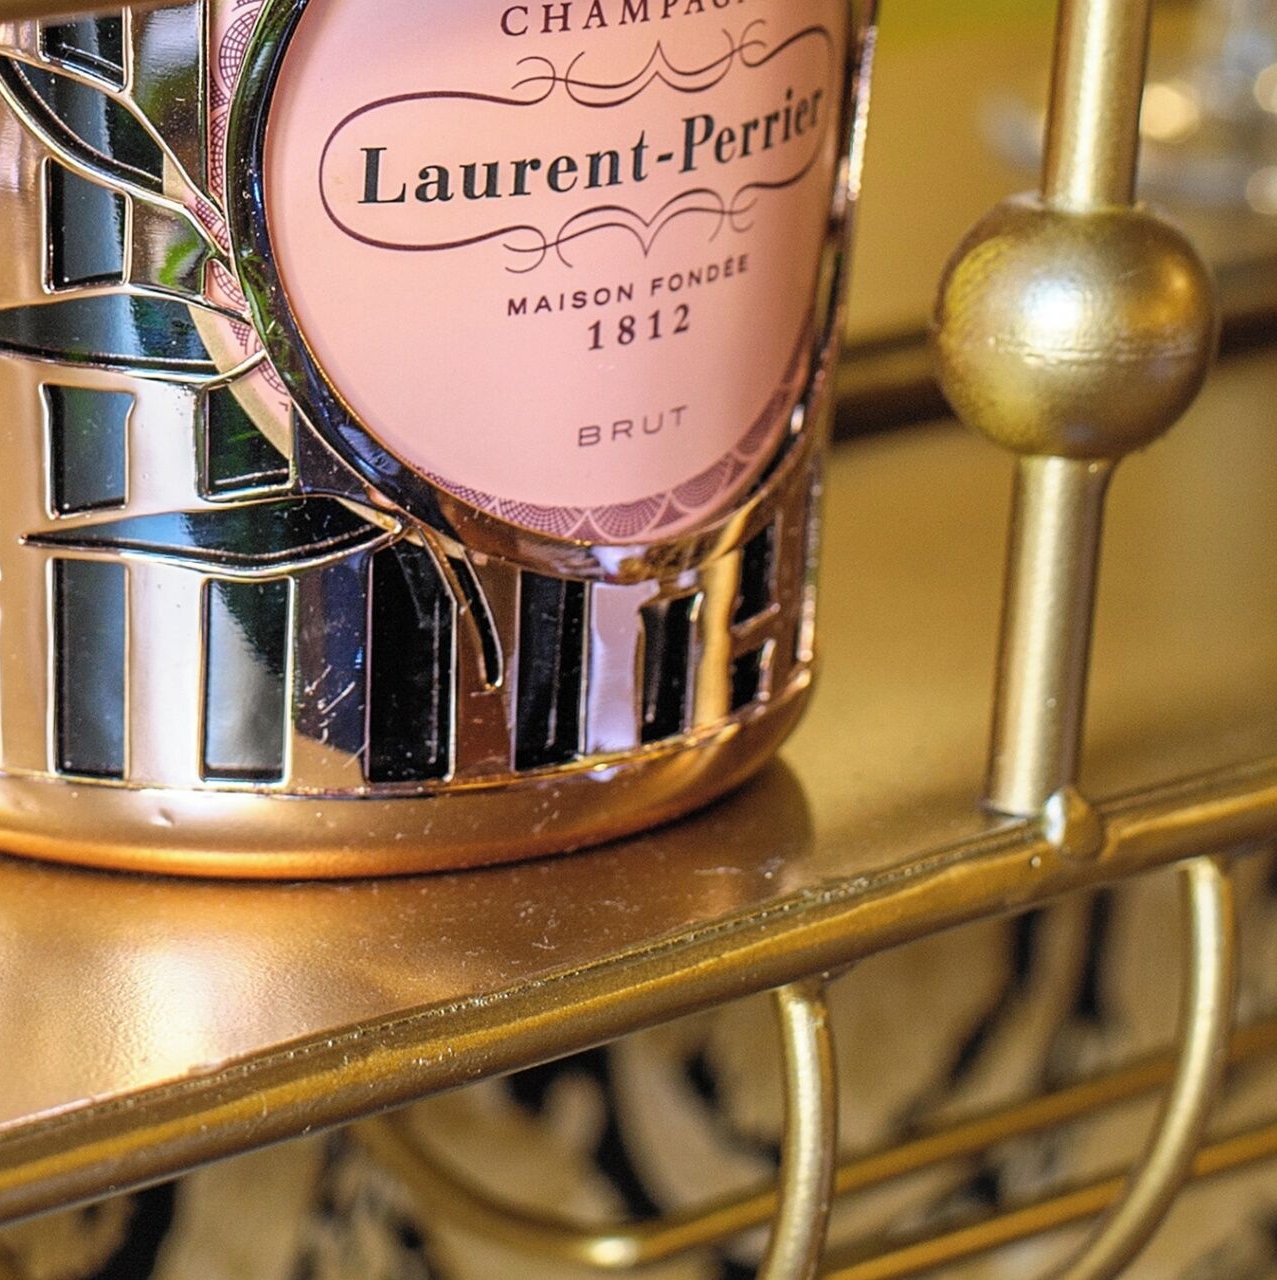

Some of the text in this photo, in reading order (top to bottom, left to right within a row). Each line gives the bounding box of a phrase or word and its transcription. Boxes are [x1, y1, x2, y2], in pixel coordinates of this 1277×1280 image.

[357, 86, 823, 204] Laurent-Perrier
[507, 253, 749, 316] MAISON FONDÉE
[588, 303, 690, 351] 1812
[578, 406, 686, 447] BRUT
